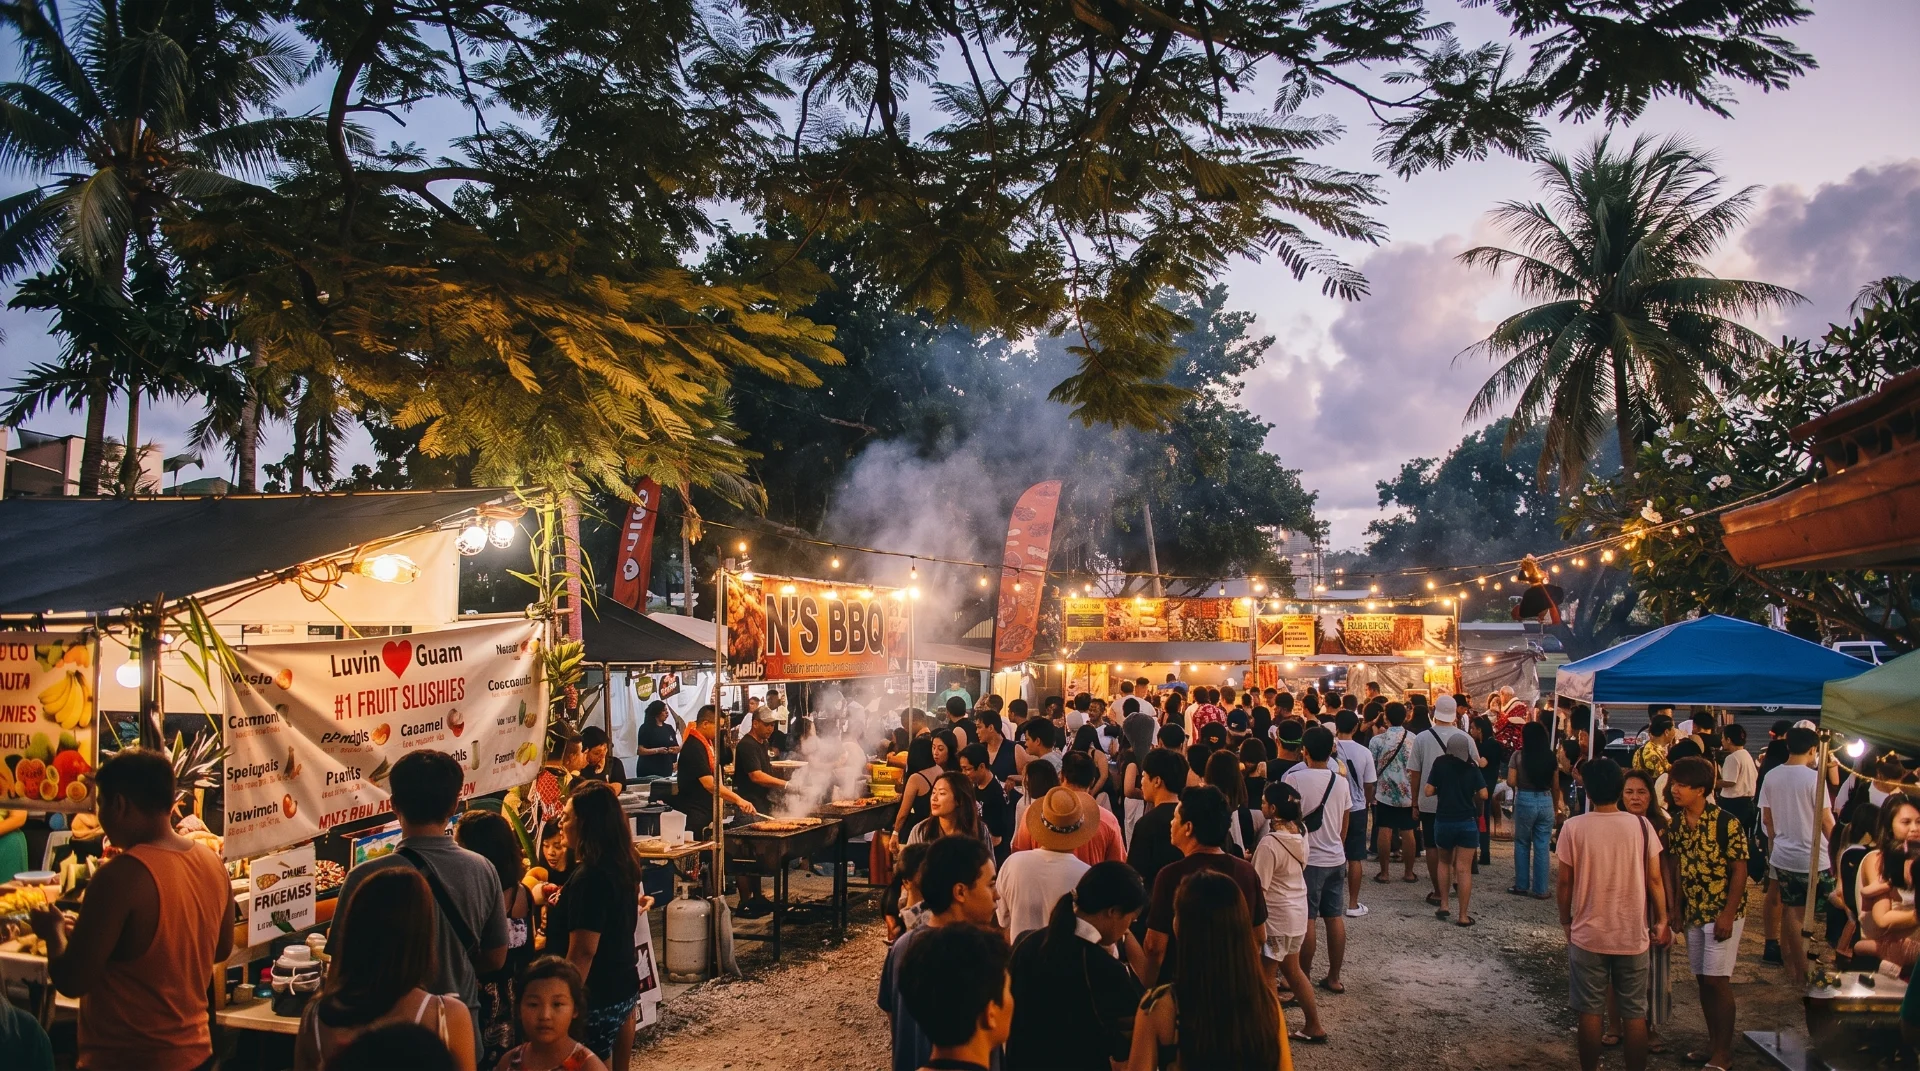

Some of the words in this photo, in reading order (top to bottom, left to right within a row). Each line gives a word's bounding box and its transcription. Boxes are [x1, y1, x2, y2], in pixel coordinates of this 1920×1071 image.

[765, 593, 819, 656] N'S
[828, 599, 885, 658] BBQ
[331, 650, 380, 677] Luvin
[416, 644, 462, 667] Guam
[335, 693, 352, 720] #1
[358, 687, 398, 717] FRUIT
[402, 677, 465, 710] SLUSHIES
